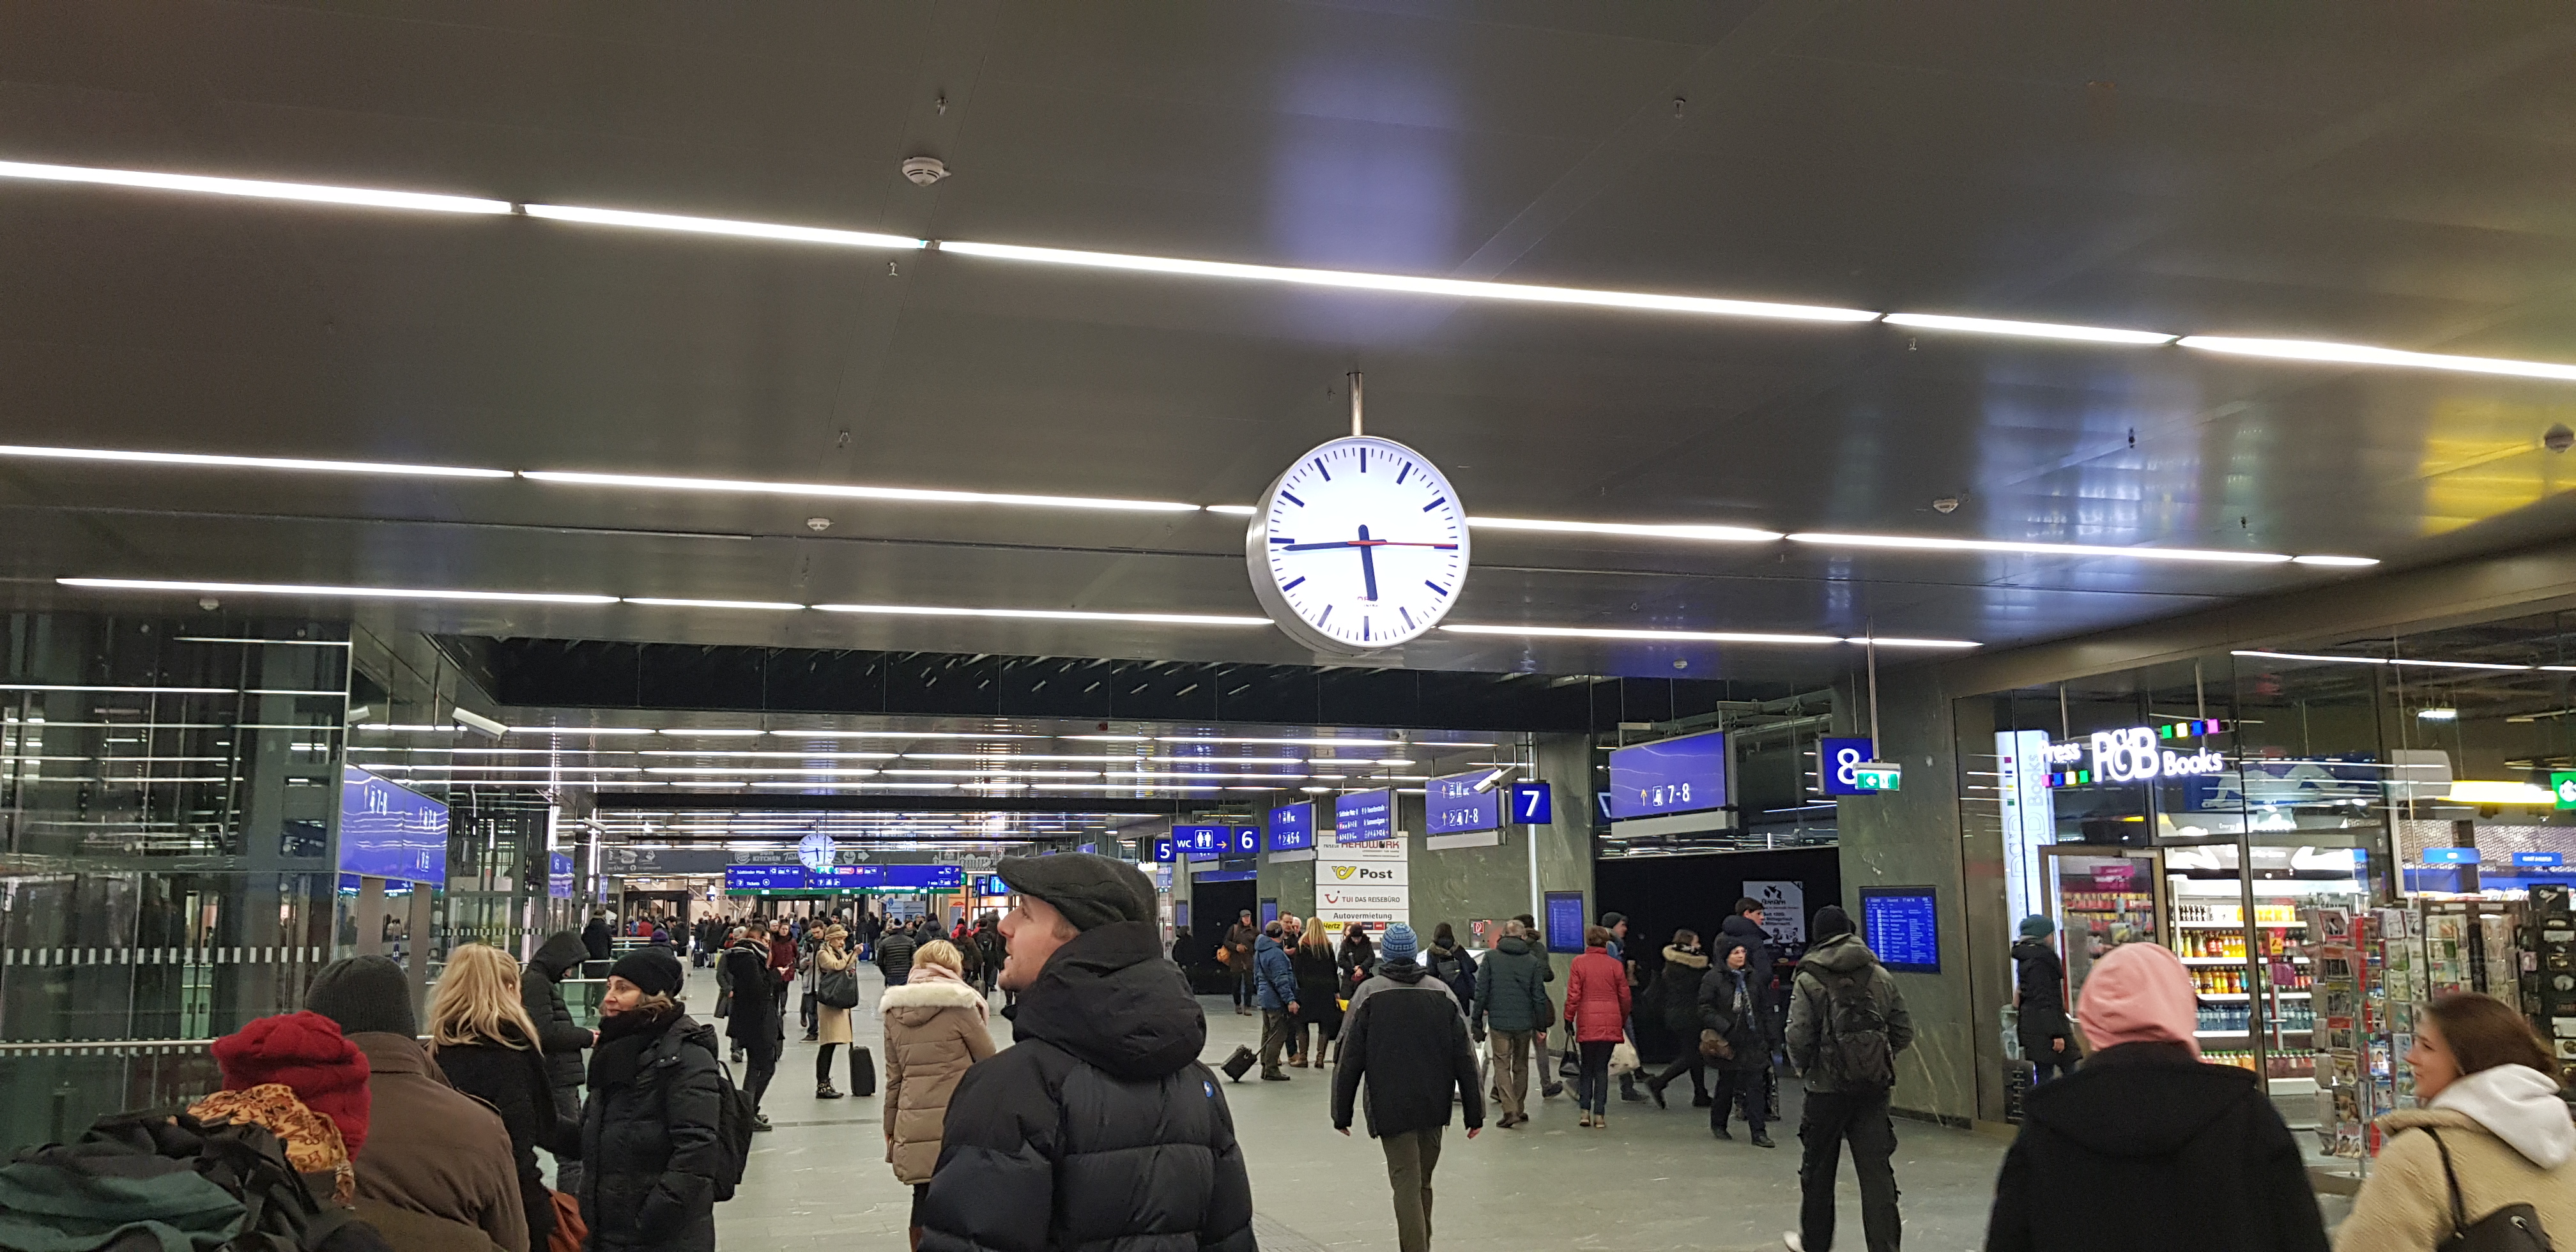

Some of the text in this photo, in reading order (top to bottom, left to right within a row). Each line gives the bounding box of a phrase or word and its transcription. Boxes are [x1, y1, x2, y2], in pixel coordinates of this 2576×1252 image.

[1836, 748, 1860, 784] 8
[2039, 740, 2081, 762] Press
[2163, 747, 2223, 776] Books
[2024, 754, 2044, 806] Books
[1667, 782, 1690, 803] 7-8
[377, 789, 388, 816] 7-8
[1522, 790, 1539, 817] 7
[1464, 808, 1478, 824] 7-8
[1176, 839, 1192, 848] WC
[1241, 830, 1254, 849] 6
[1291, 832, 1300, 844] 5-6
[1160, 843, 1170, 859] 5
[1360, 868, 1393, 879] Post
[1333, 912, 1392, 920] Autovermietung
